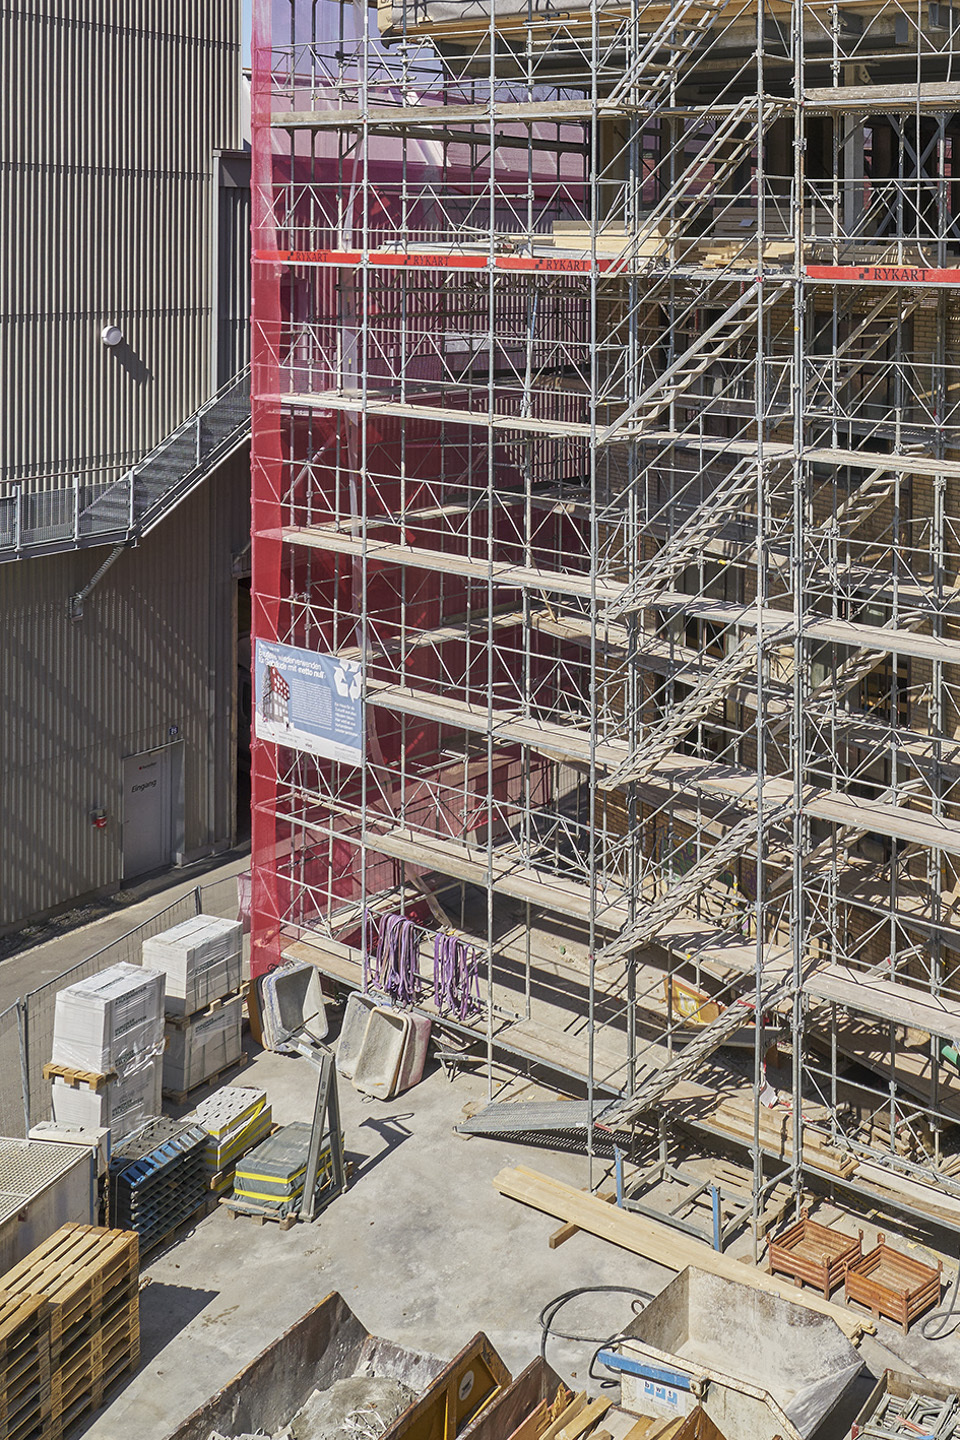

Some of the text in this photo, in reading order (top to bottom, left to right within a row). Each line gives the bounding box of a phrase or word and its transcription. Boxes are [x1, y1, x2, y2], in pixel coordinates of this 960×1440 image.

[414, 255, 450, 267] RYKART
[546, 259, 588, 271] RYKART
[873, 267, 929, 282] RYKART
[131, 779, 157, 793] Eingang
